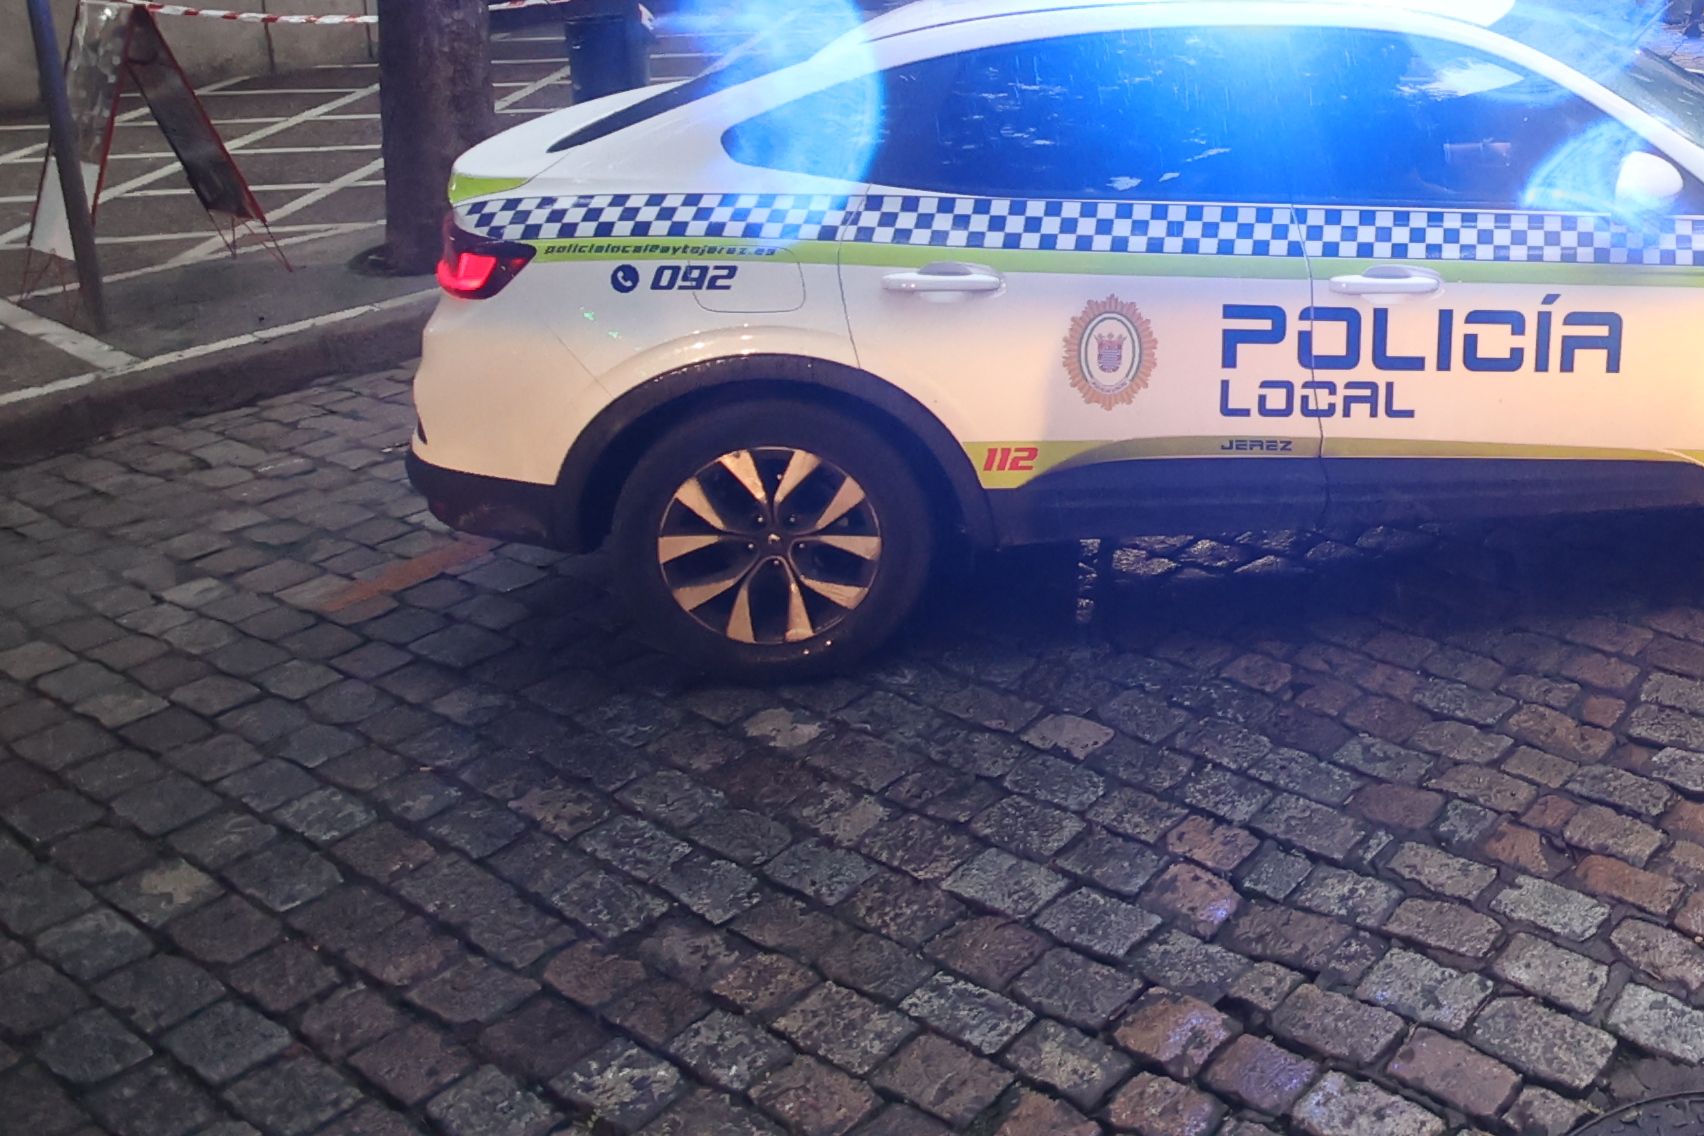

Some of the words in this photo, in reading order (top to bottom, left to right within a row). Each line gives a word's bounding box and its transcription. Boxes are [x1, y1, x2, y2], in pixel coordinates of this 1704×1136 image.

[543, 242, 777, 257] policialocal@aytojerez.es
[649, 264, 739, 291] 092
[1221, 293, 1623, 374] POLICÍA
[1219, 379, 1416, 418] LOCAL
[1220, 439, 1293, 452] JEREZ
[983, 447, 1039, 472] 112
